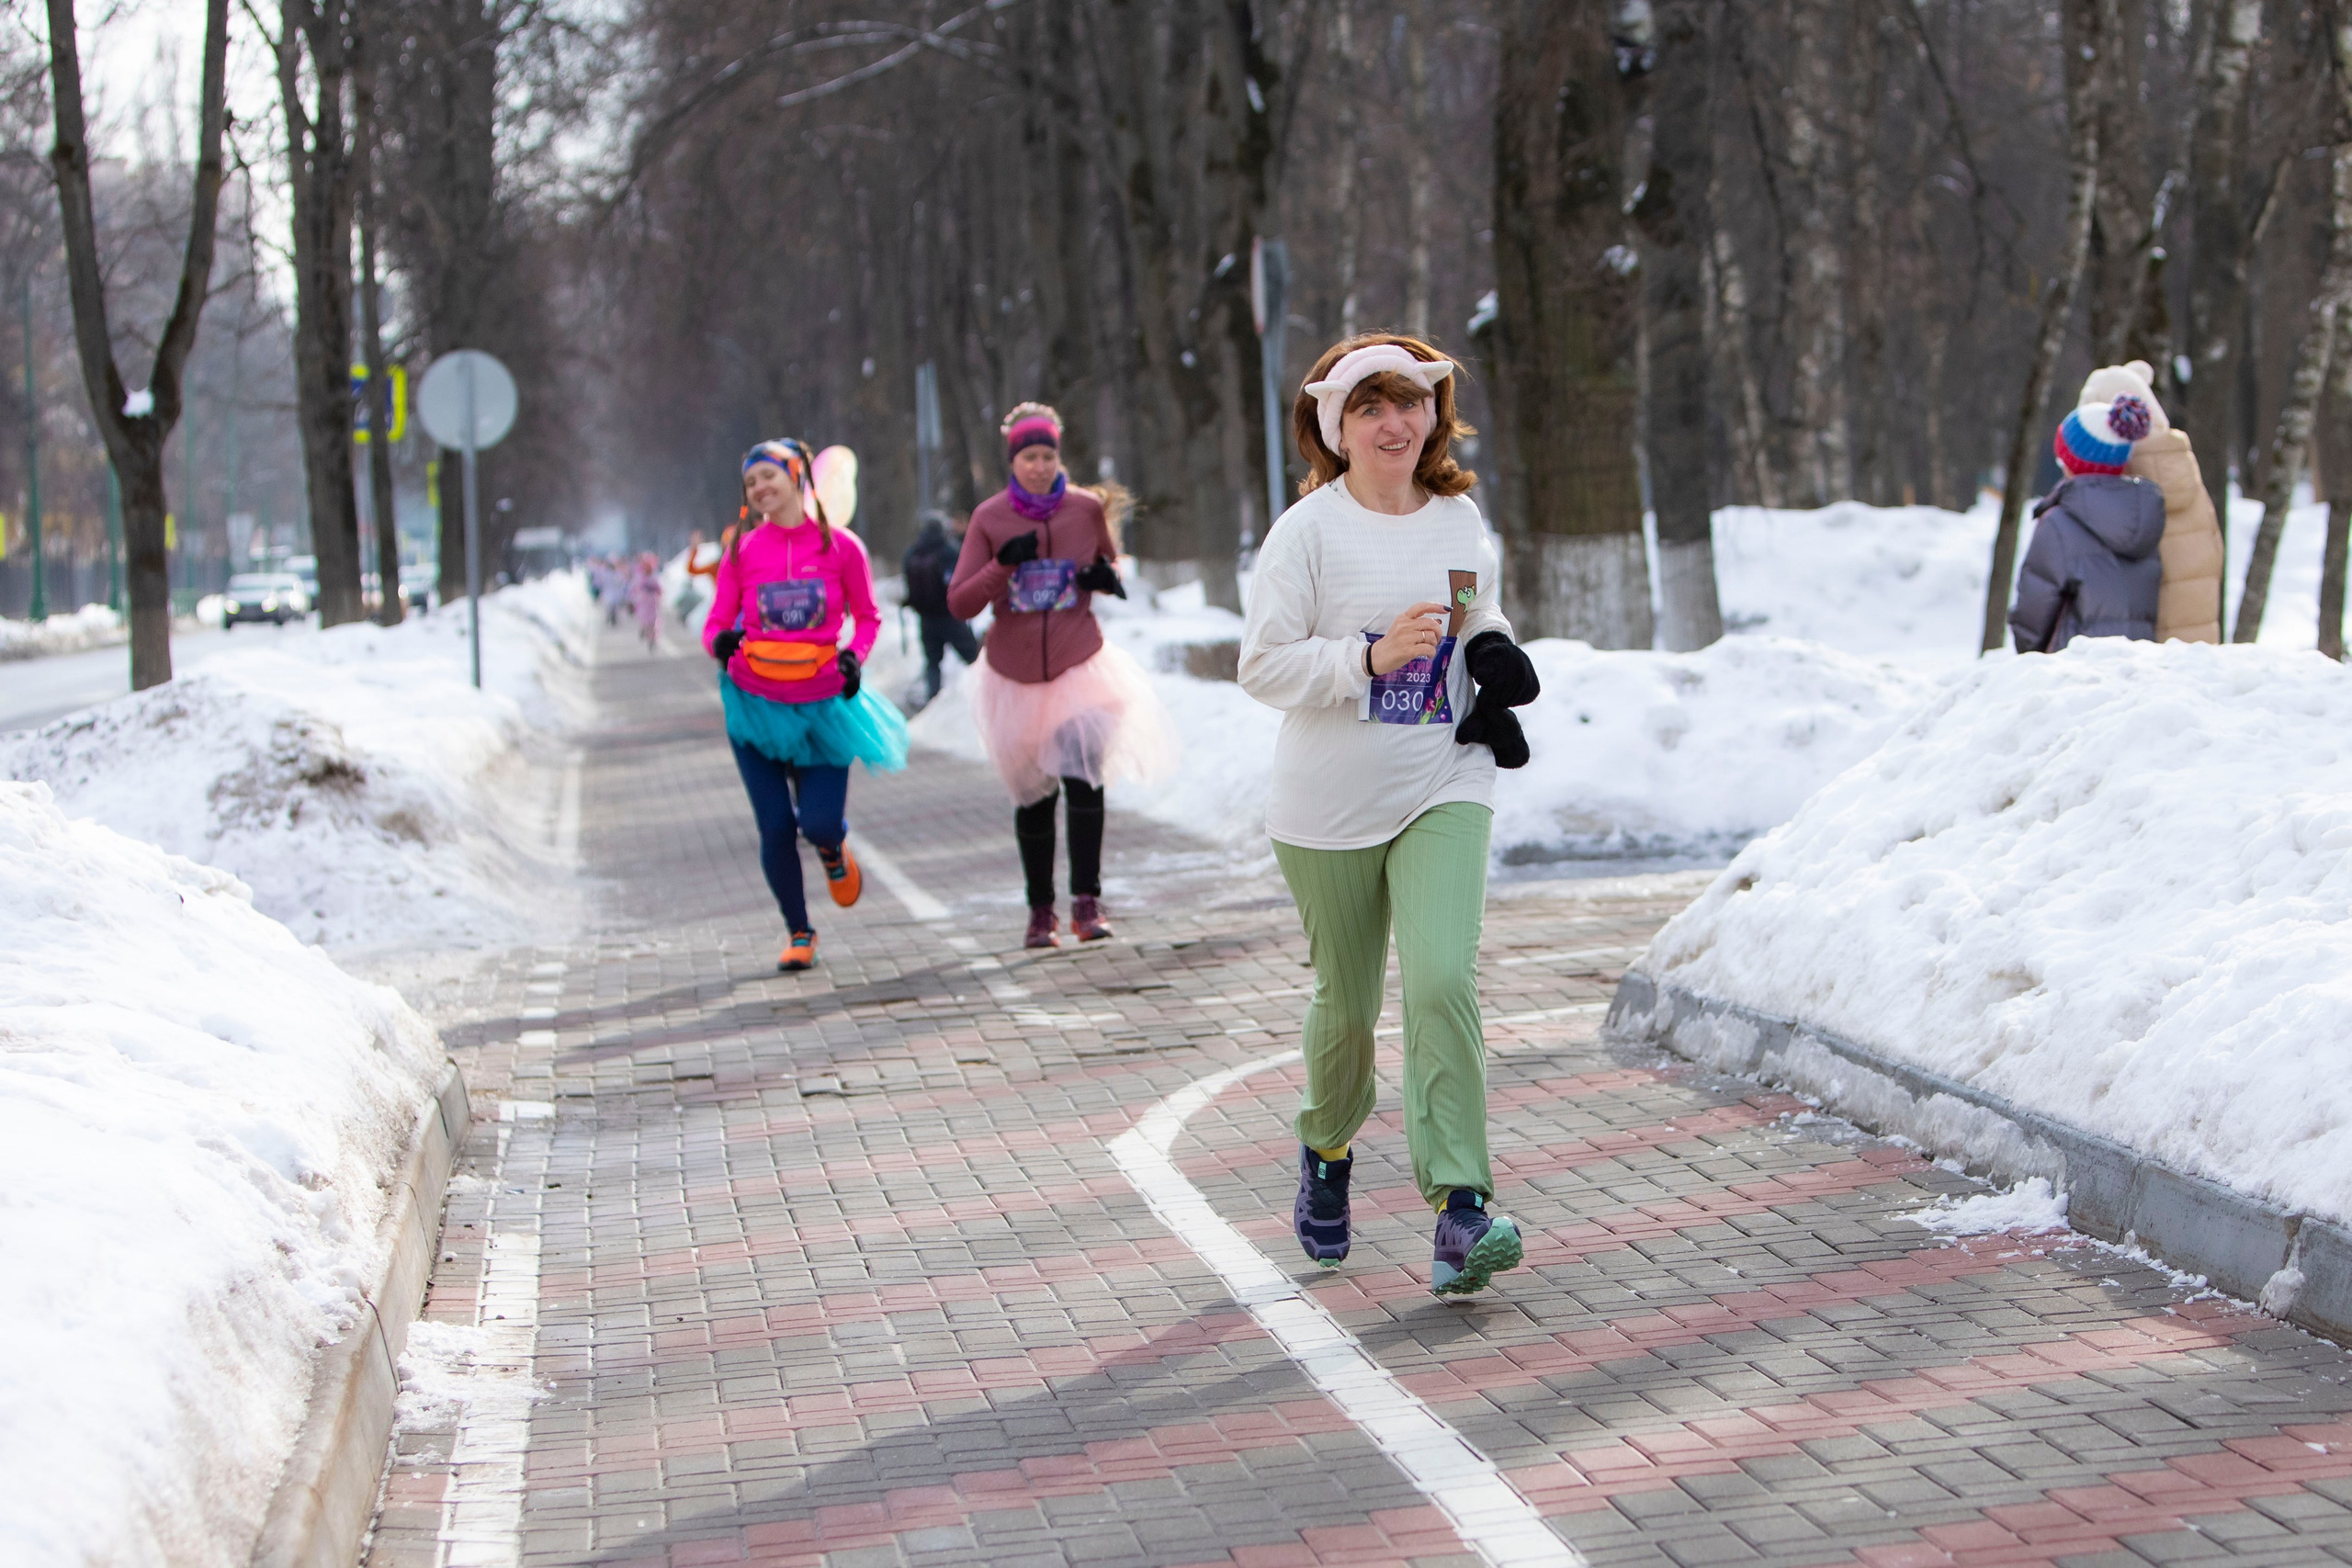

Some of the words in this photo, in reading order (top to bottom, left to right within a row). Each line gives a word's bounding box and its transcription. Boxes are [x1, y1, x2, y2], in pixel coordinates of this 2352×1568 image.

[782, 609, 805, 624] 091
[1406, 671, 1431, 683] 2023
[1381, 689, 1424, 712] 030
